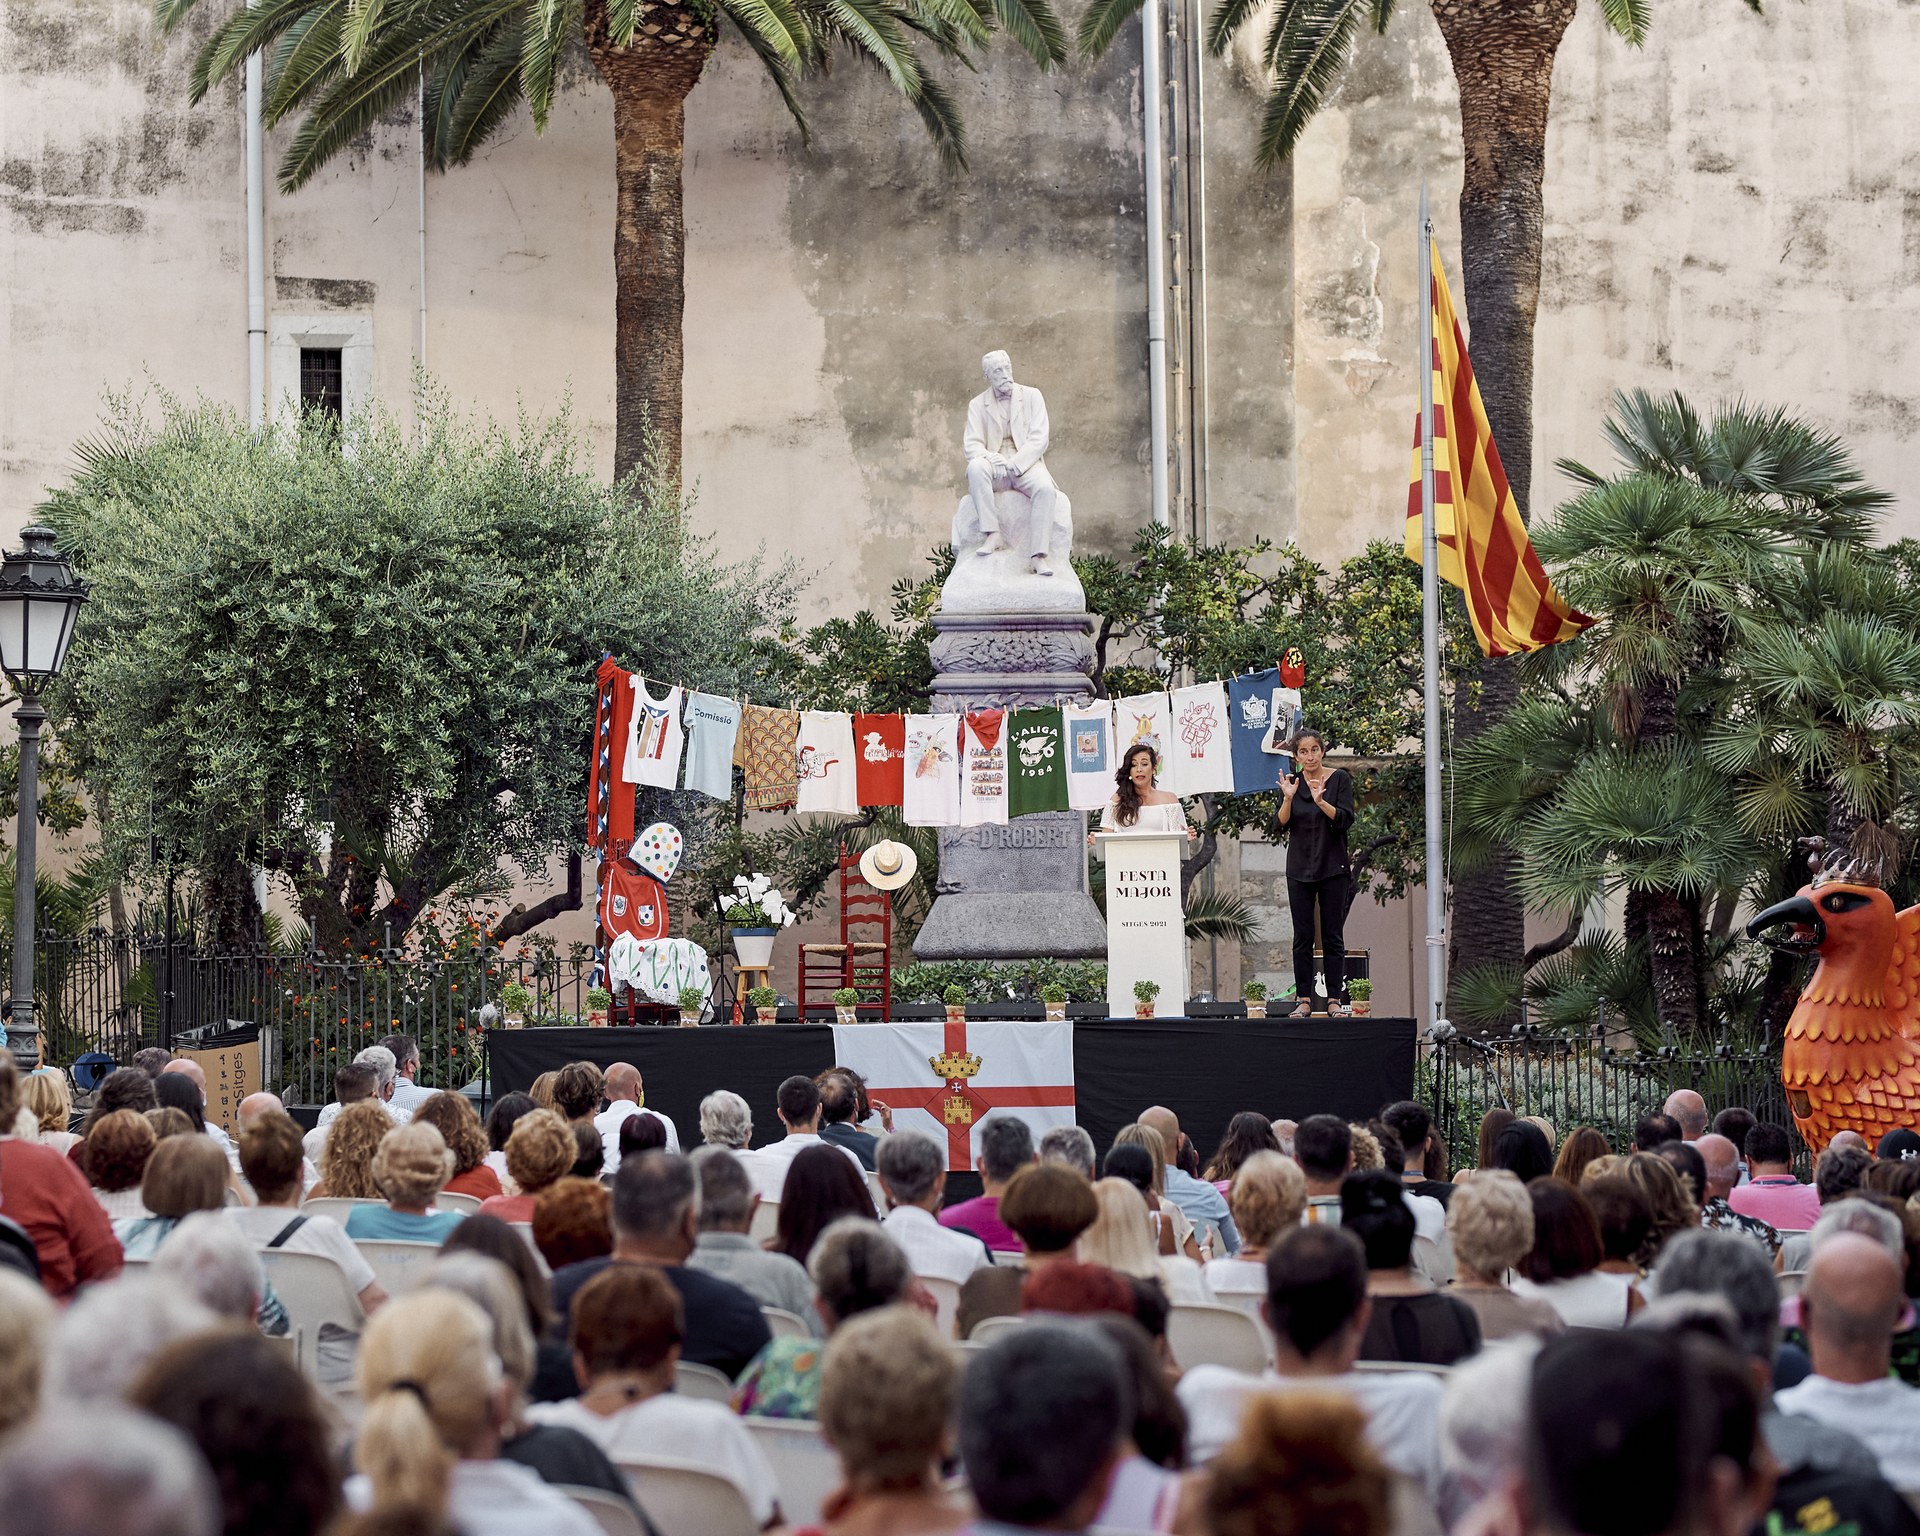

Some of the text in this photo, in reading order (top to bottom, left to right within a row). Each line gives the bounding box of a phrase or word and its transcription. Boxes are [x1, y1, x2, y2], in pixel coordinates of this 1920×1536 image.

[694, 707, 732, 725] Comissió
[1011, 725, 1058, 743] L'ALIGA
[1021, 764, 1053, 777] 1984
[998, 826, 1071, 849] ROBERT
[1119, 870, 1167, 882] FESTA
[1115, 886, 1172, 899] MAJOR
